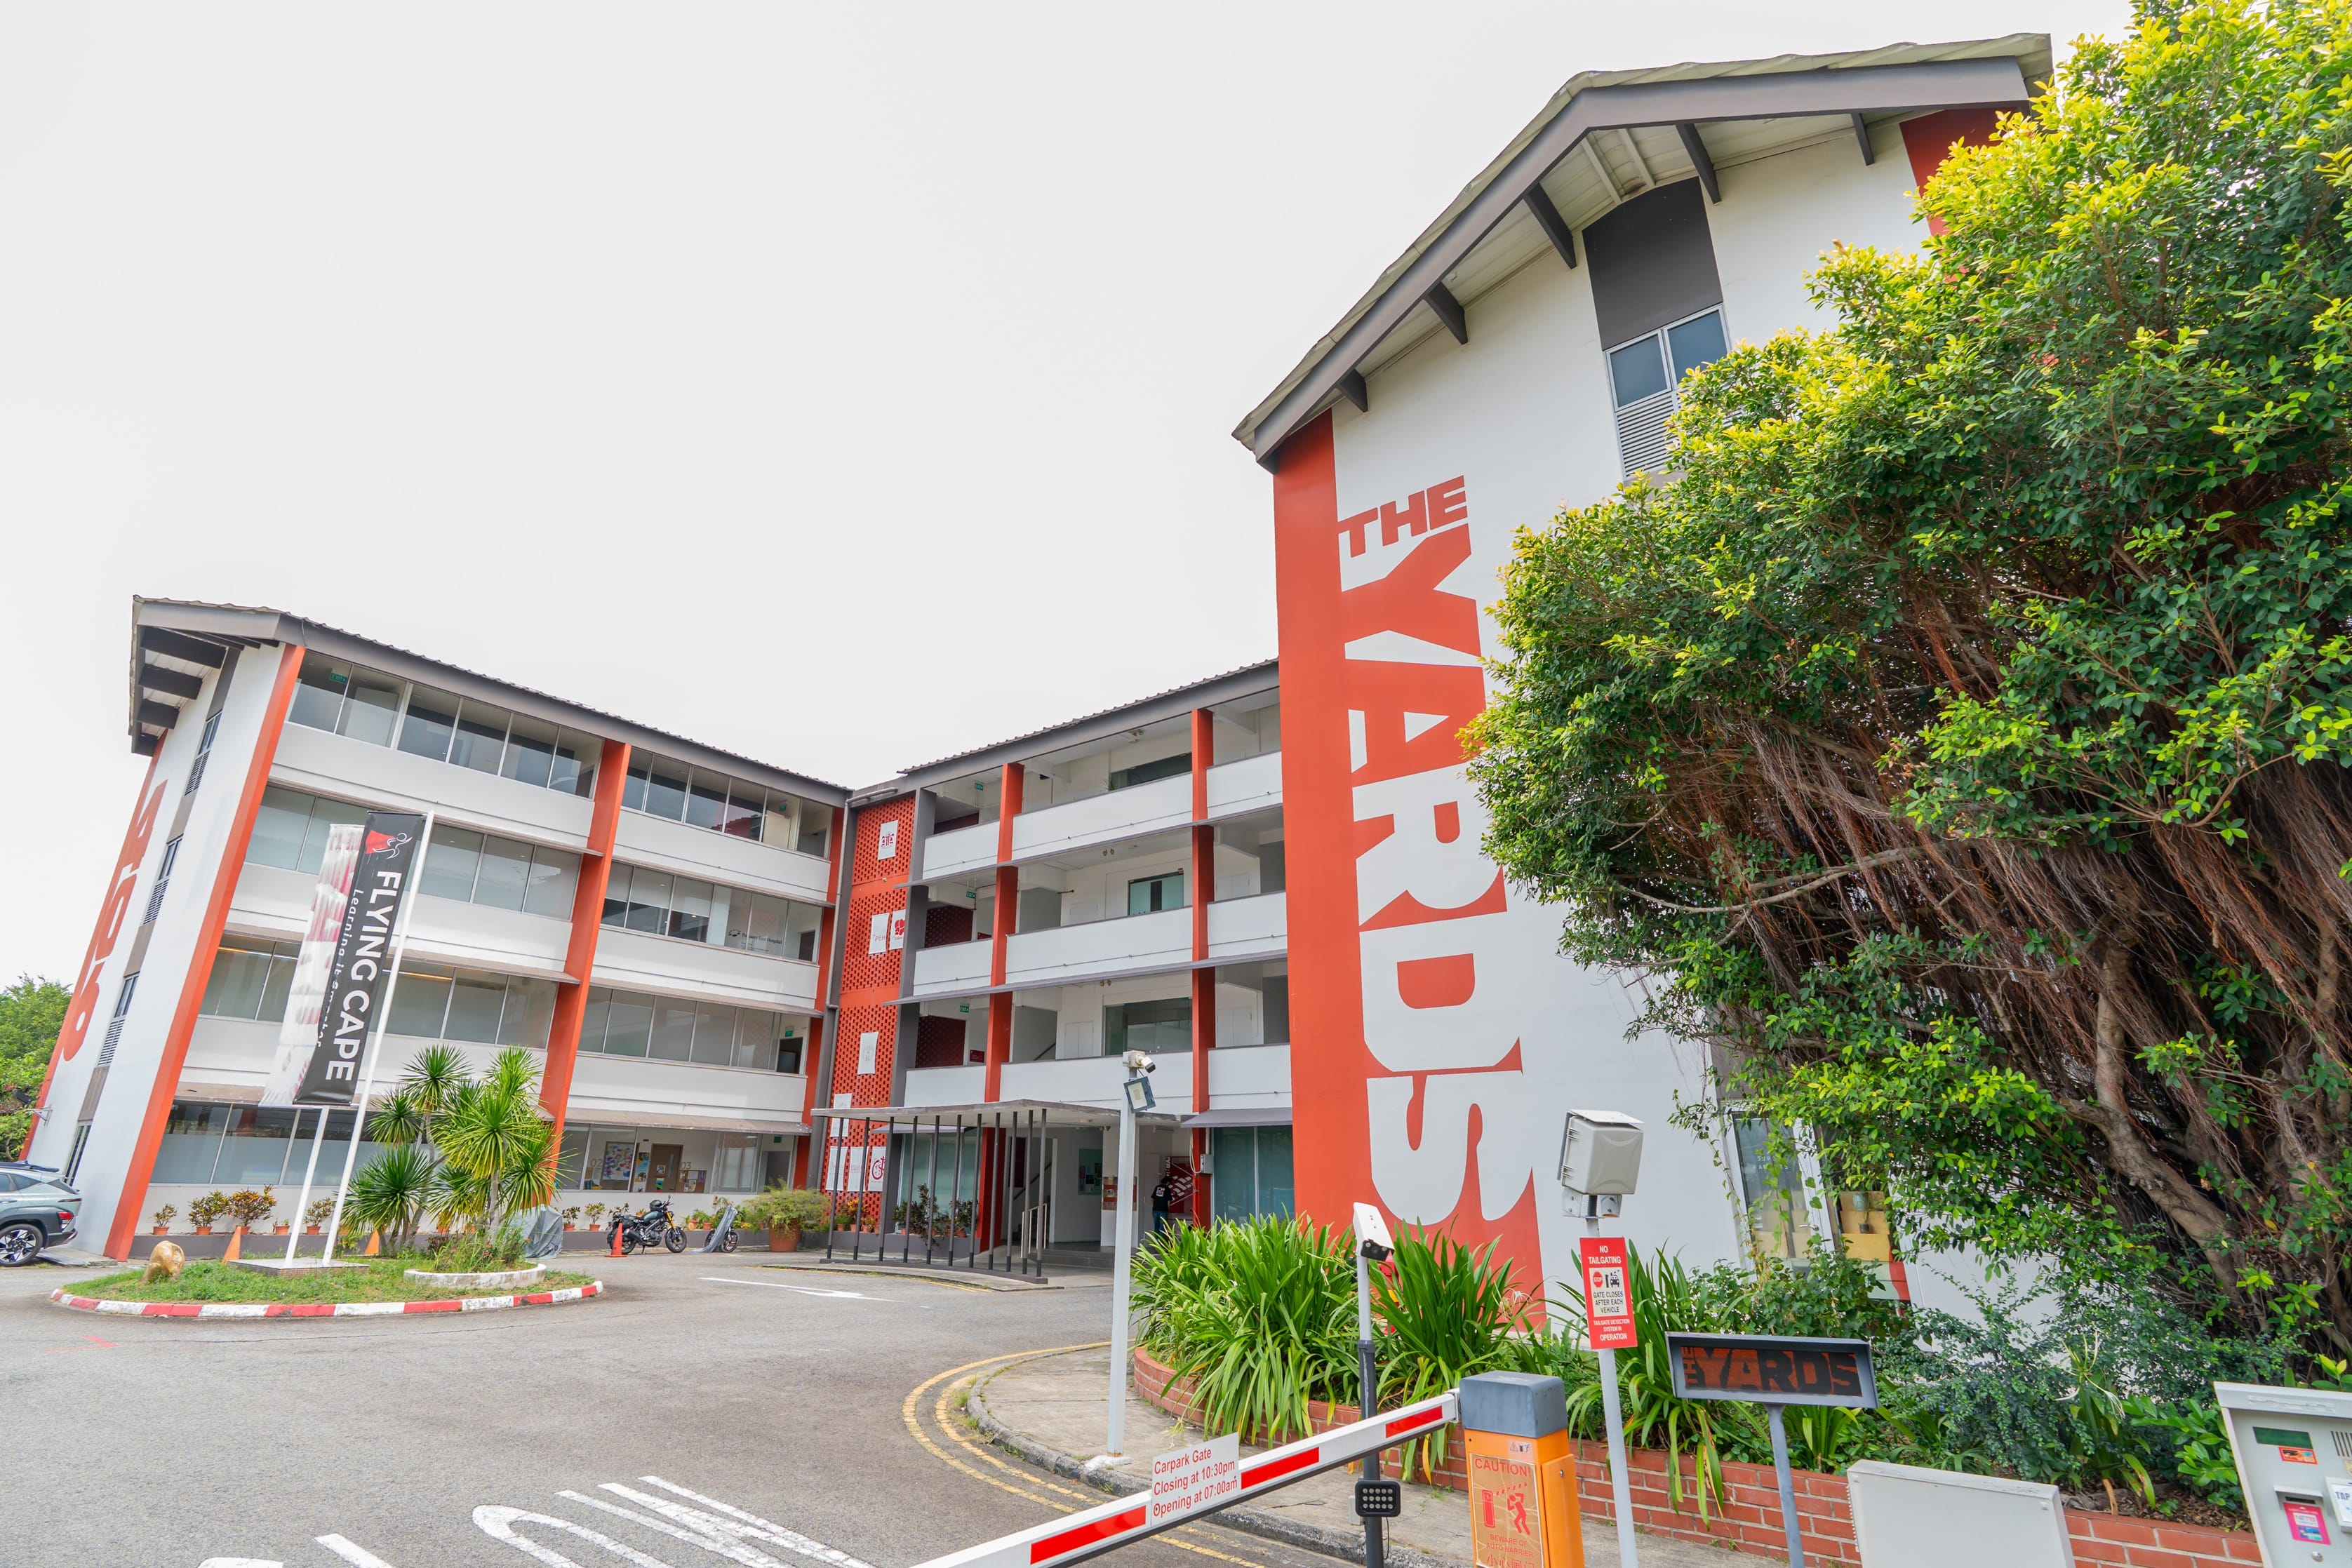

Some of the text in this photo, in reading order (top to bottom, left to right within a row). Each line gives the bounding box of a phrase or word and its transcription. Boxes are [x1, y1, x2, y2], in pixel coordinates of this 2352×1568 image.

[1334, 474, 1468, 558] THE
[1339, 522, 1532, 1226] YARDS
[326, 870, 403, 1081] FLYING CAPE
[1599, 1245, 1609, 1254] NO
[1588, 1256, 1622, 1265] TAILGATING
[1600, 1306, 1620, 1314] VEHICLE
[1599, 1332, 1628, 1342] OPERATION
[1693, 1347, 1863, 1397] YARDS
[1154, 1447, 1212, 1475] Carpark Gate
[1474, 1458, 1532, 1478] CAUTION!
[1154, 1461, 1235, 1496] Closing at 10:30pm
[1153, 1478, 1238, 1518] Opening at 07:00am
[2335, 1491, 2351, 1501] TAP
[1486, 1542, 1534, 1557] AUTO BARRIER
[1490, 1534, 1528, 1548] BEWARE OF
